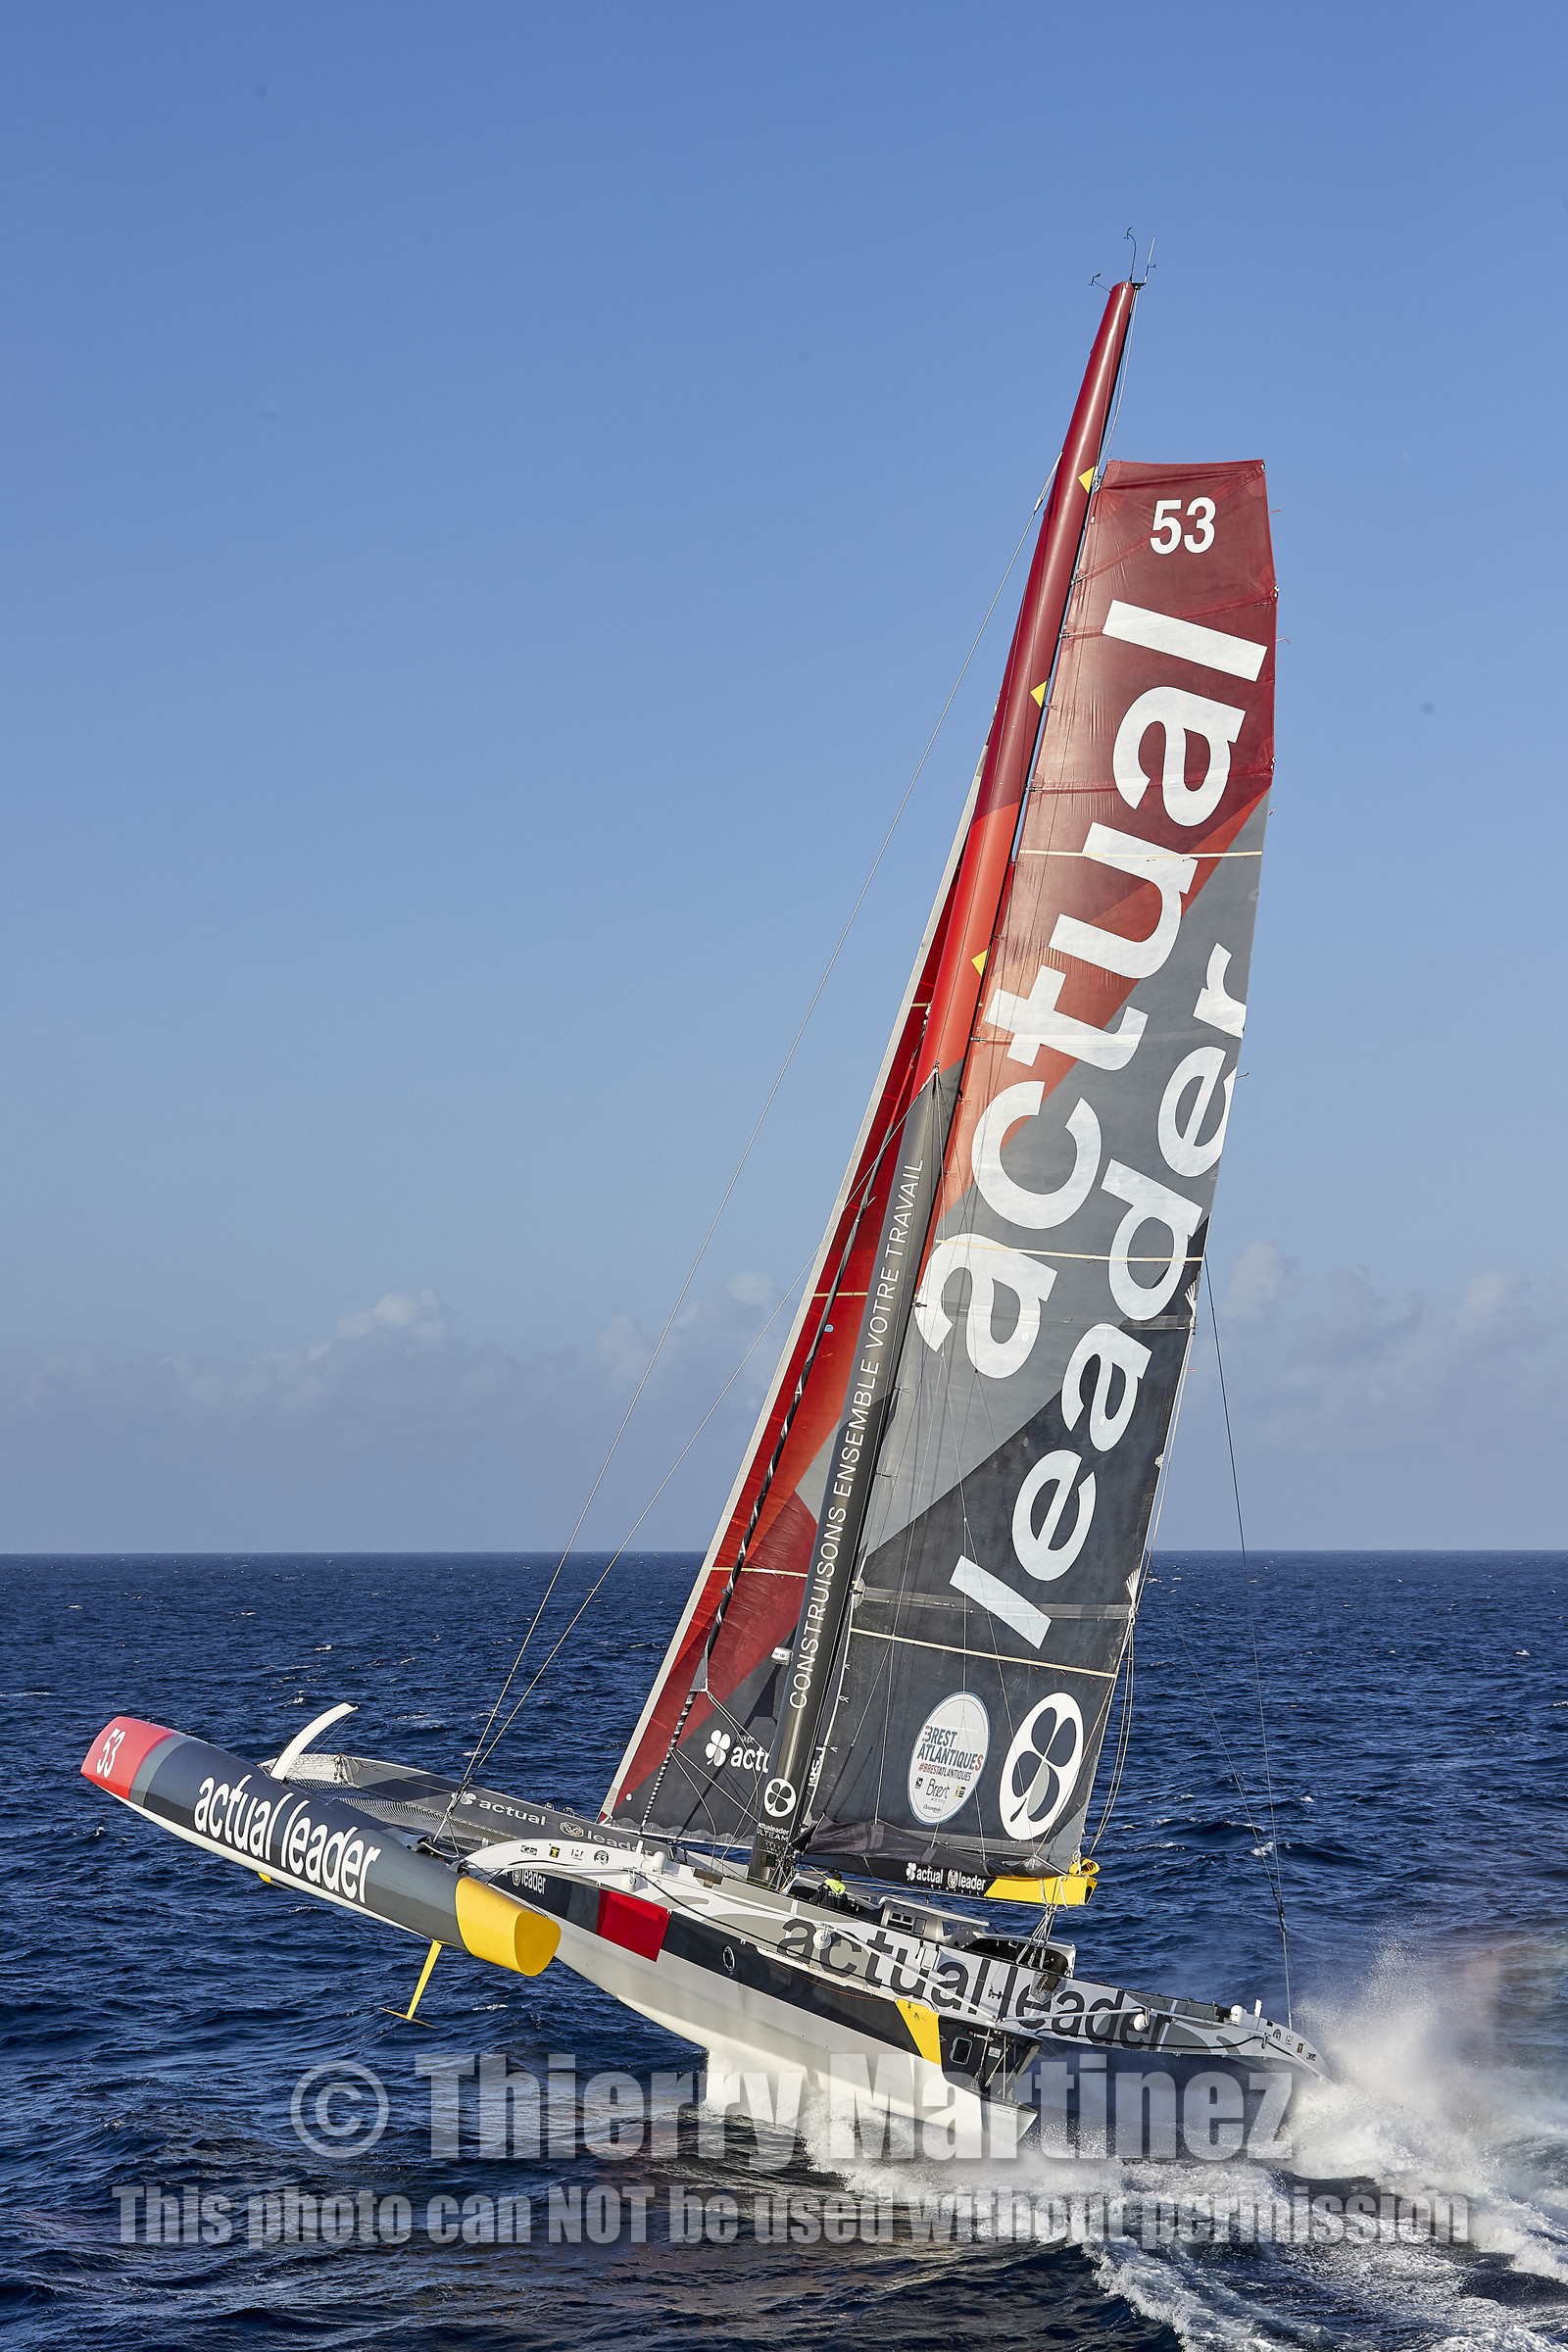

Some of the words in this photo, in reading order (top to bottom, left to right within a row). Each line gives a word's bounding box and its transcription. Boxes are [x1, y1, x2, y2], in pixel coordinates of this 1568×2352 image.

[1150, 497, 1216, 554] 53
[915, 599, 1268, 1379] actual
[950, 943, 1247, 1649] leader
[789, 1506, 847, 1709] CONSTRUISONS
[833, 1358, 880, 1498] ENSEMBLE
[865, 1266, 900, 1349] VOTRE
[885, 1159, 924, 1258] TRAVAIL
[96, 1729, 126, 1779] 53
[917, 1742, 984, 1772] ATLANTIQUES
[922, 1725, 958, 1748] BREST
[194, 1774, 294, 1860] actual
[280, 1799, 381, 1904] leader
[478, 1799, 547, 1826] actual
[521, 1869, 547, 1895] leader
[916, 1867, 944, 1885] actual
[957, 1872, 987, 1891] leader
[777, 1918, 991, 2015] actual
[999, 1966, 1175, 2050] leader
